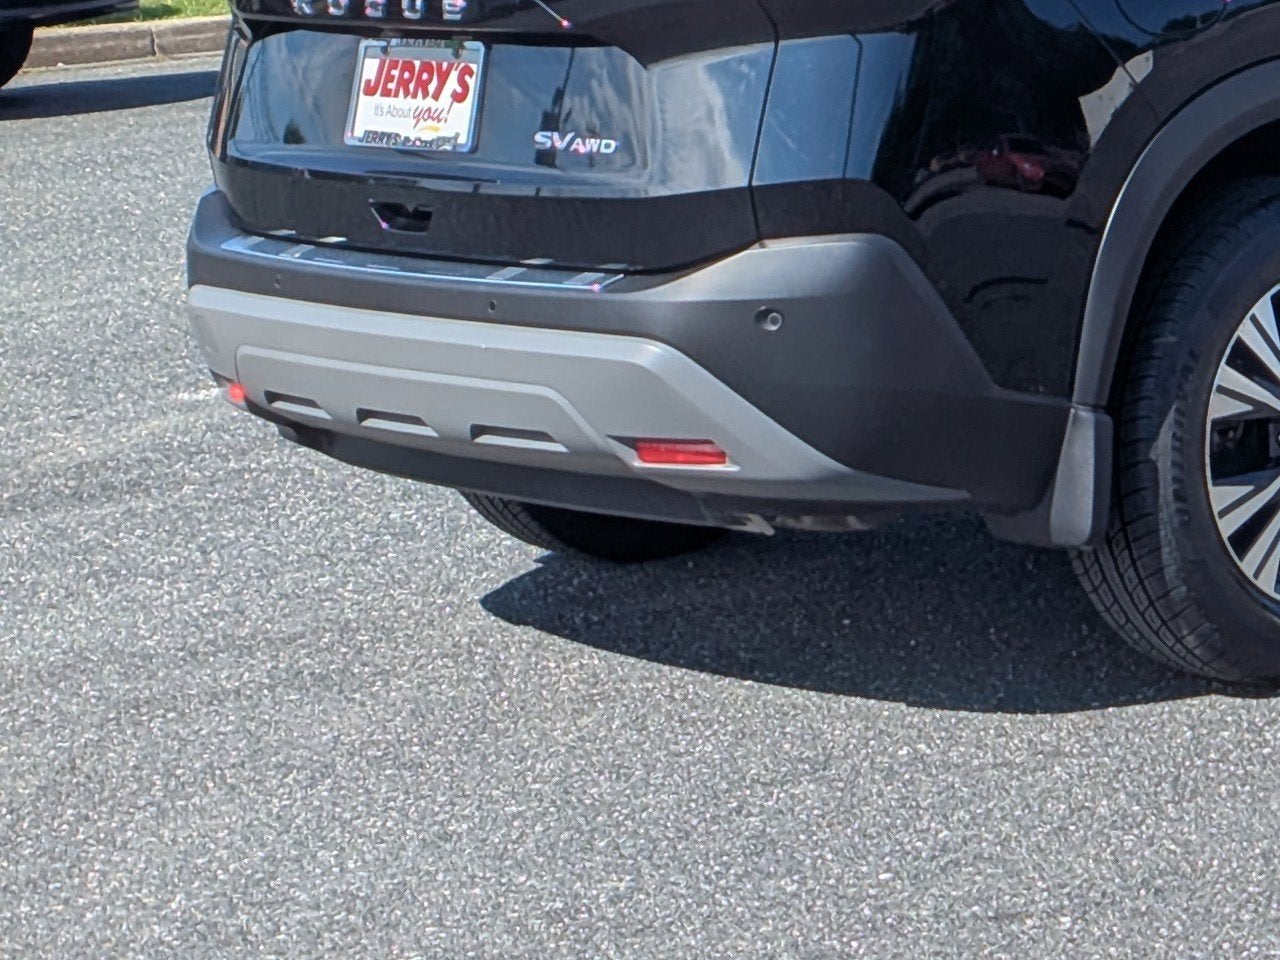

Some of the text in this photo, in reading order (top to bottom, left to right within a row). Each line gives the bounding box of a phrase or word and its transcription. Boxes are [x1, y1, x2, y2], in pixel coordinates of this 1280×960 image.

[362, 58, 475, 104] JERRY'S
[385, 104, 412, 119] About
[412, 100, 454, 129] you!
[534, 131, 617, 154] SV AWD
